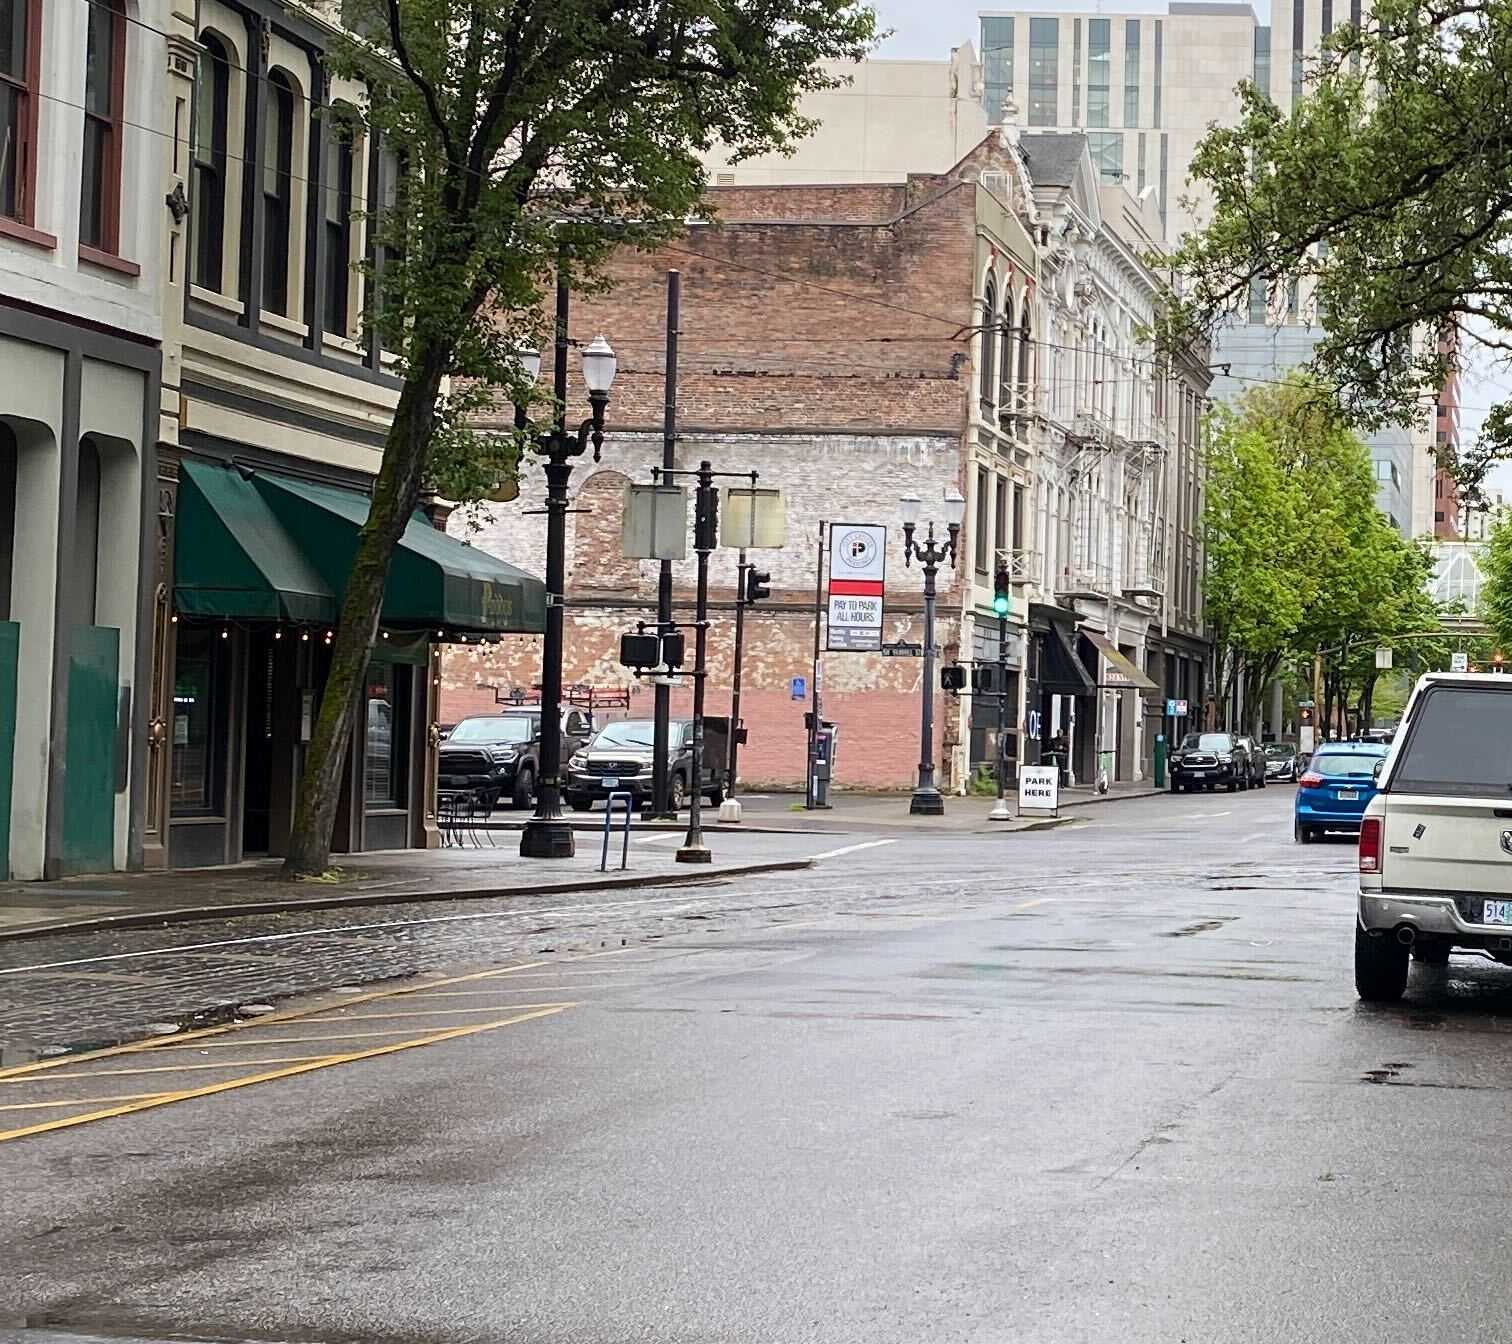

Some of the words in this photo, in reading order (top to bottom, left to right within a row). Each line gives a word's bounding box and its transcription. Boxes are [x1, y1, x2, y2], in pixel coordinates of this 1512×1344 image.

[833, 600, 847, 611] PAY
[848, 600, 858, 611] TO
[858, 600, 878, 612] PARK
[836, 610, 849, 622] ALL
[850, 611, 875, 623] HOURS
[1024, 777, 1053, 785] PARK
[1024, 789, 1052, 797] HERE
[1485, 902, 1506, 919] 514
